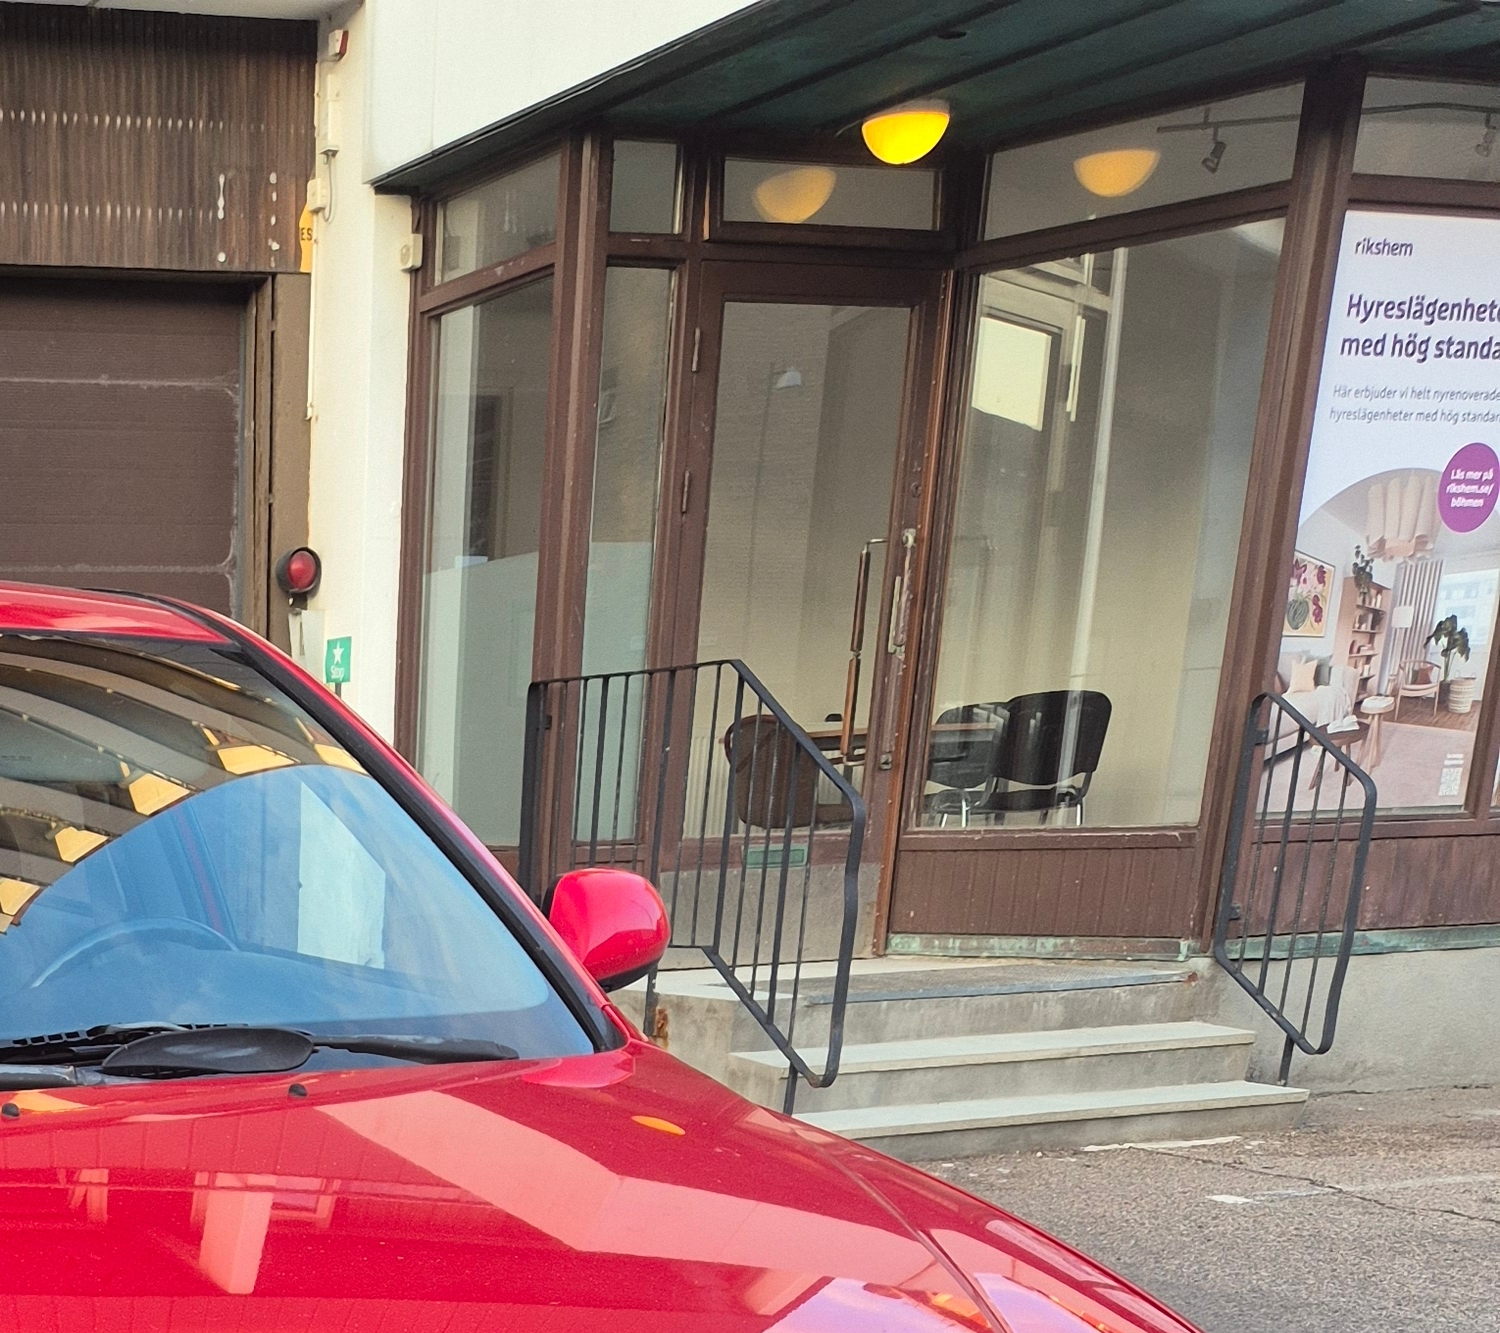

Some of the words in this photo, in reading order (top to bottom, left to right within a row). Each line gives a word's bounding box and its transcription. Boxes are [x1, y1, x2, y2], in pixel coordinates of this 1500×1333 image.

[1355, 237, 1414, 256] rikshem
[1340, 332, 1387, 357] med
[1390, 332, 1432, 364] hög
[1332, 384, 1352, 398] Här
[1353, 386, 1397, 401] erbjuder
[1399, 387, 1409, 400] vi
[1411, 387, 1431, 400] helt
[1329, 407, 1414, 424] hyreslägenheter
[1414, 410, 1438, 422] med
[1440, 409, 1458, 425] hög
